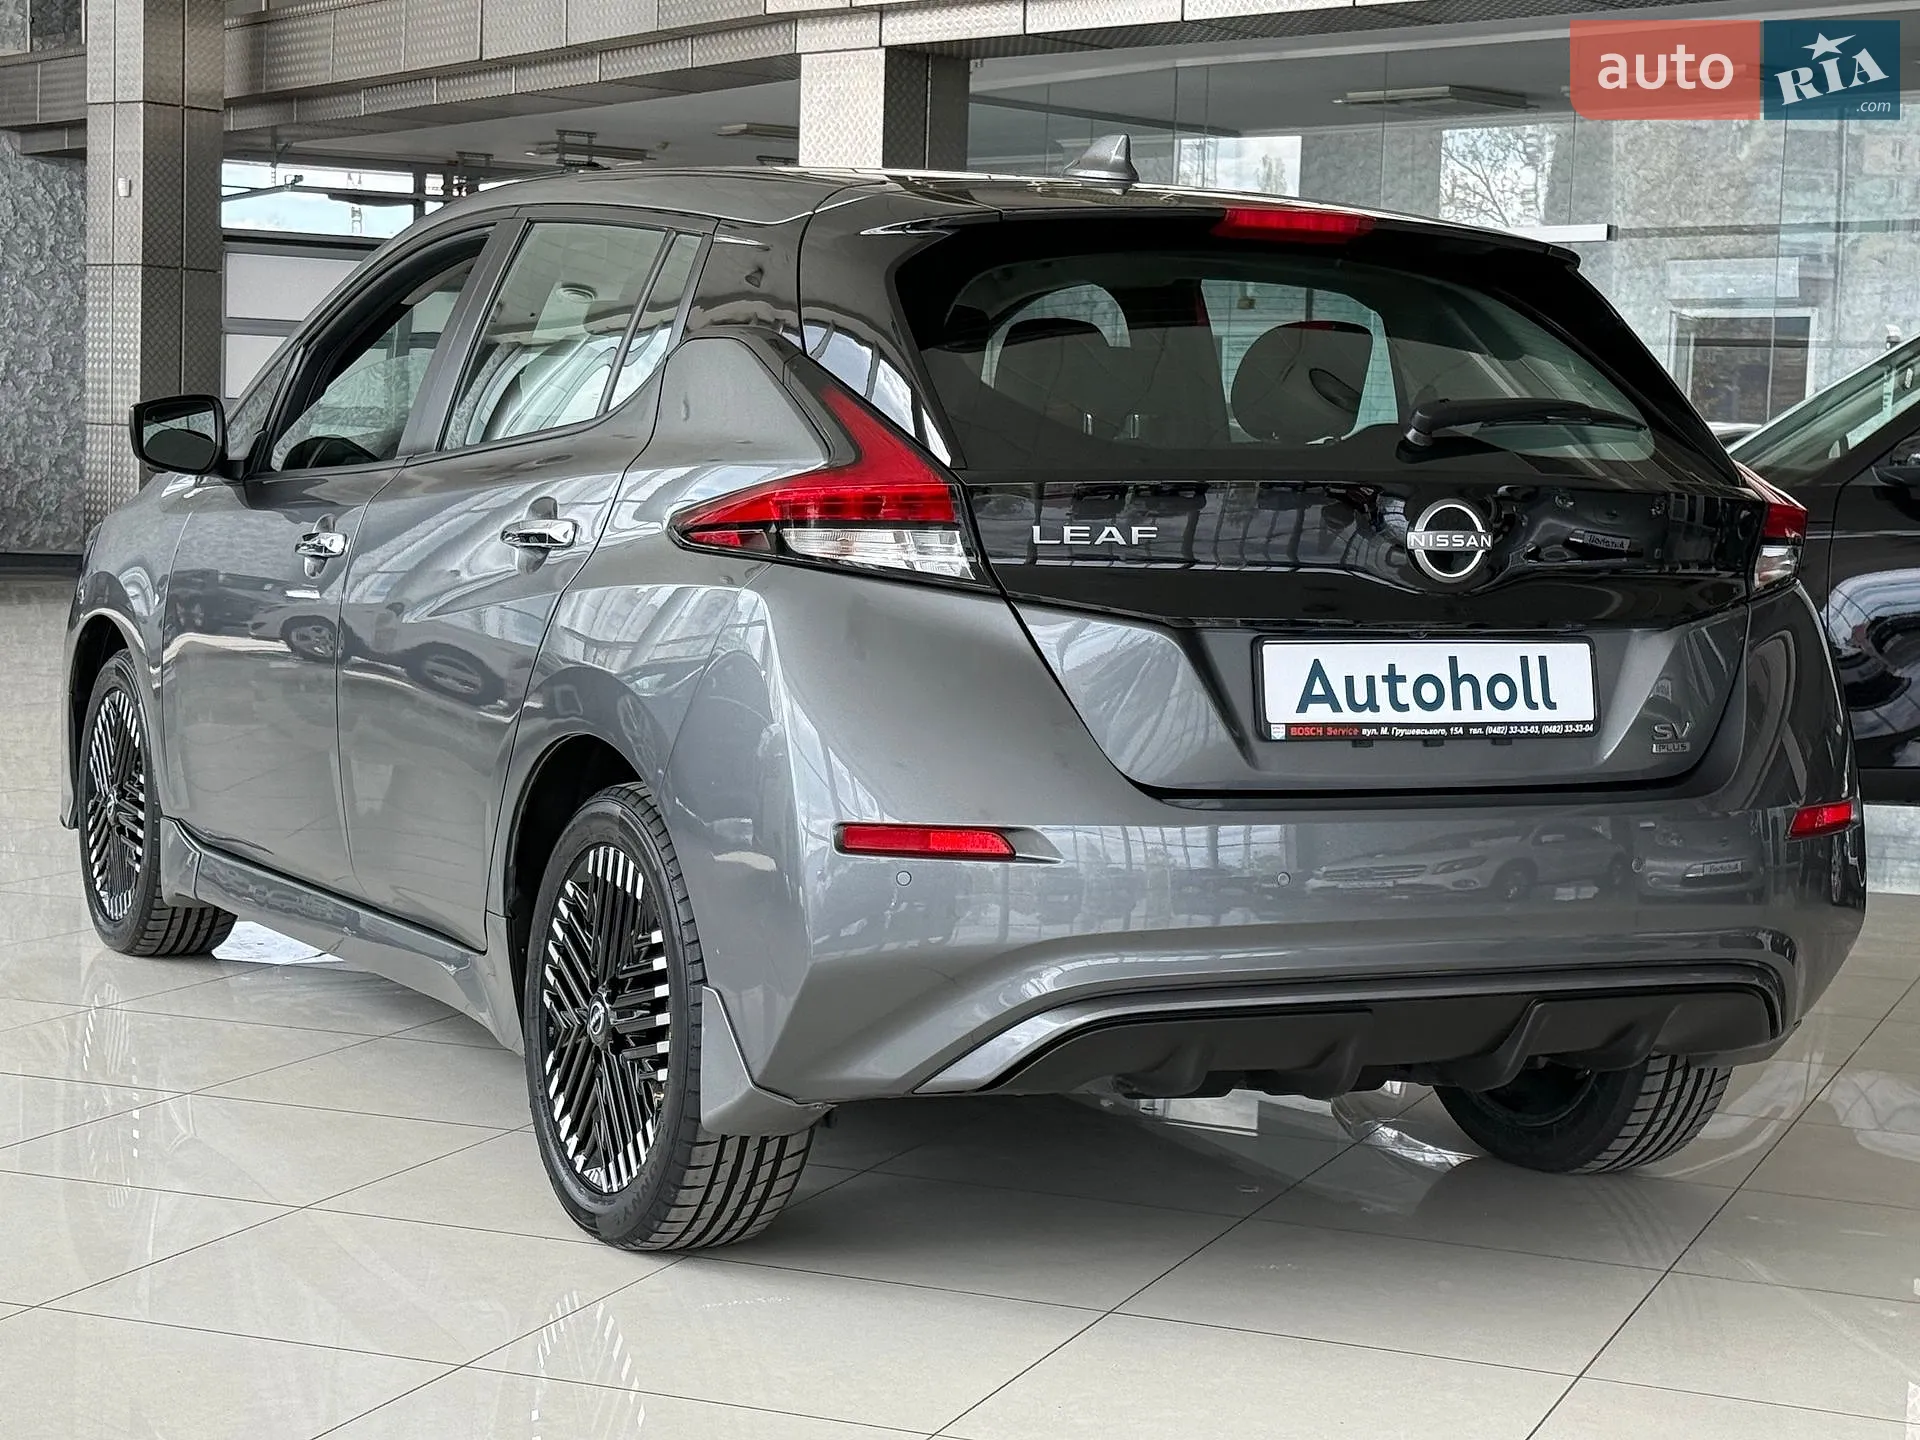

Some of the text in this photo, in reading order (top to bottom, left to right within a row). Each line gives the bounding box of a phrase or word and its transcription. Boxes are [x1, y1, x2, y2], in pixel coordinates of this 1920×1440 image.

[1031, 525, 1159, 546] LEAF
[1410, 533, 1493, 549] NISSAN
[1295, 655, 1558, 714] Autoholl
[1290, 726, 1323, 736] BOSCH
[1326, 726, 1360, 736] Service
[1653, 721, 1690, 740] SV
